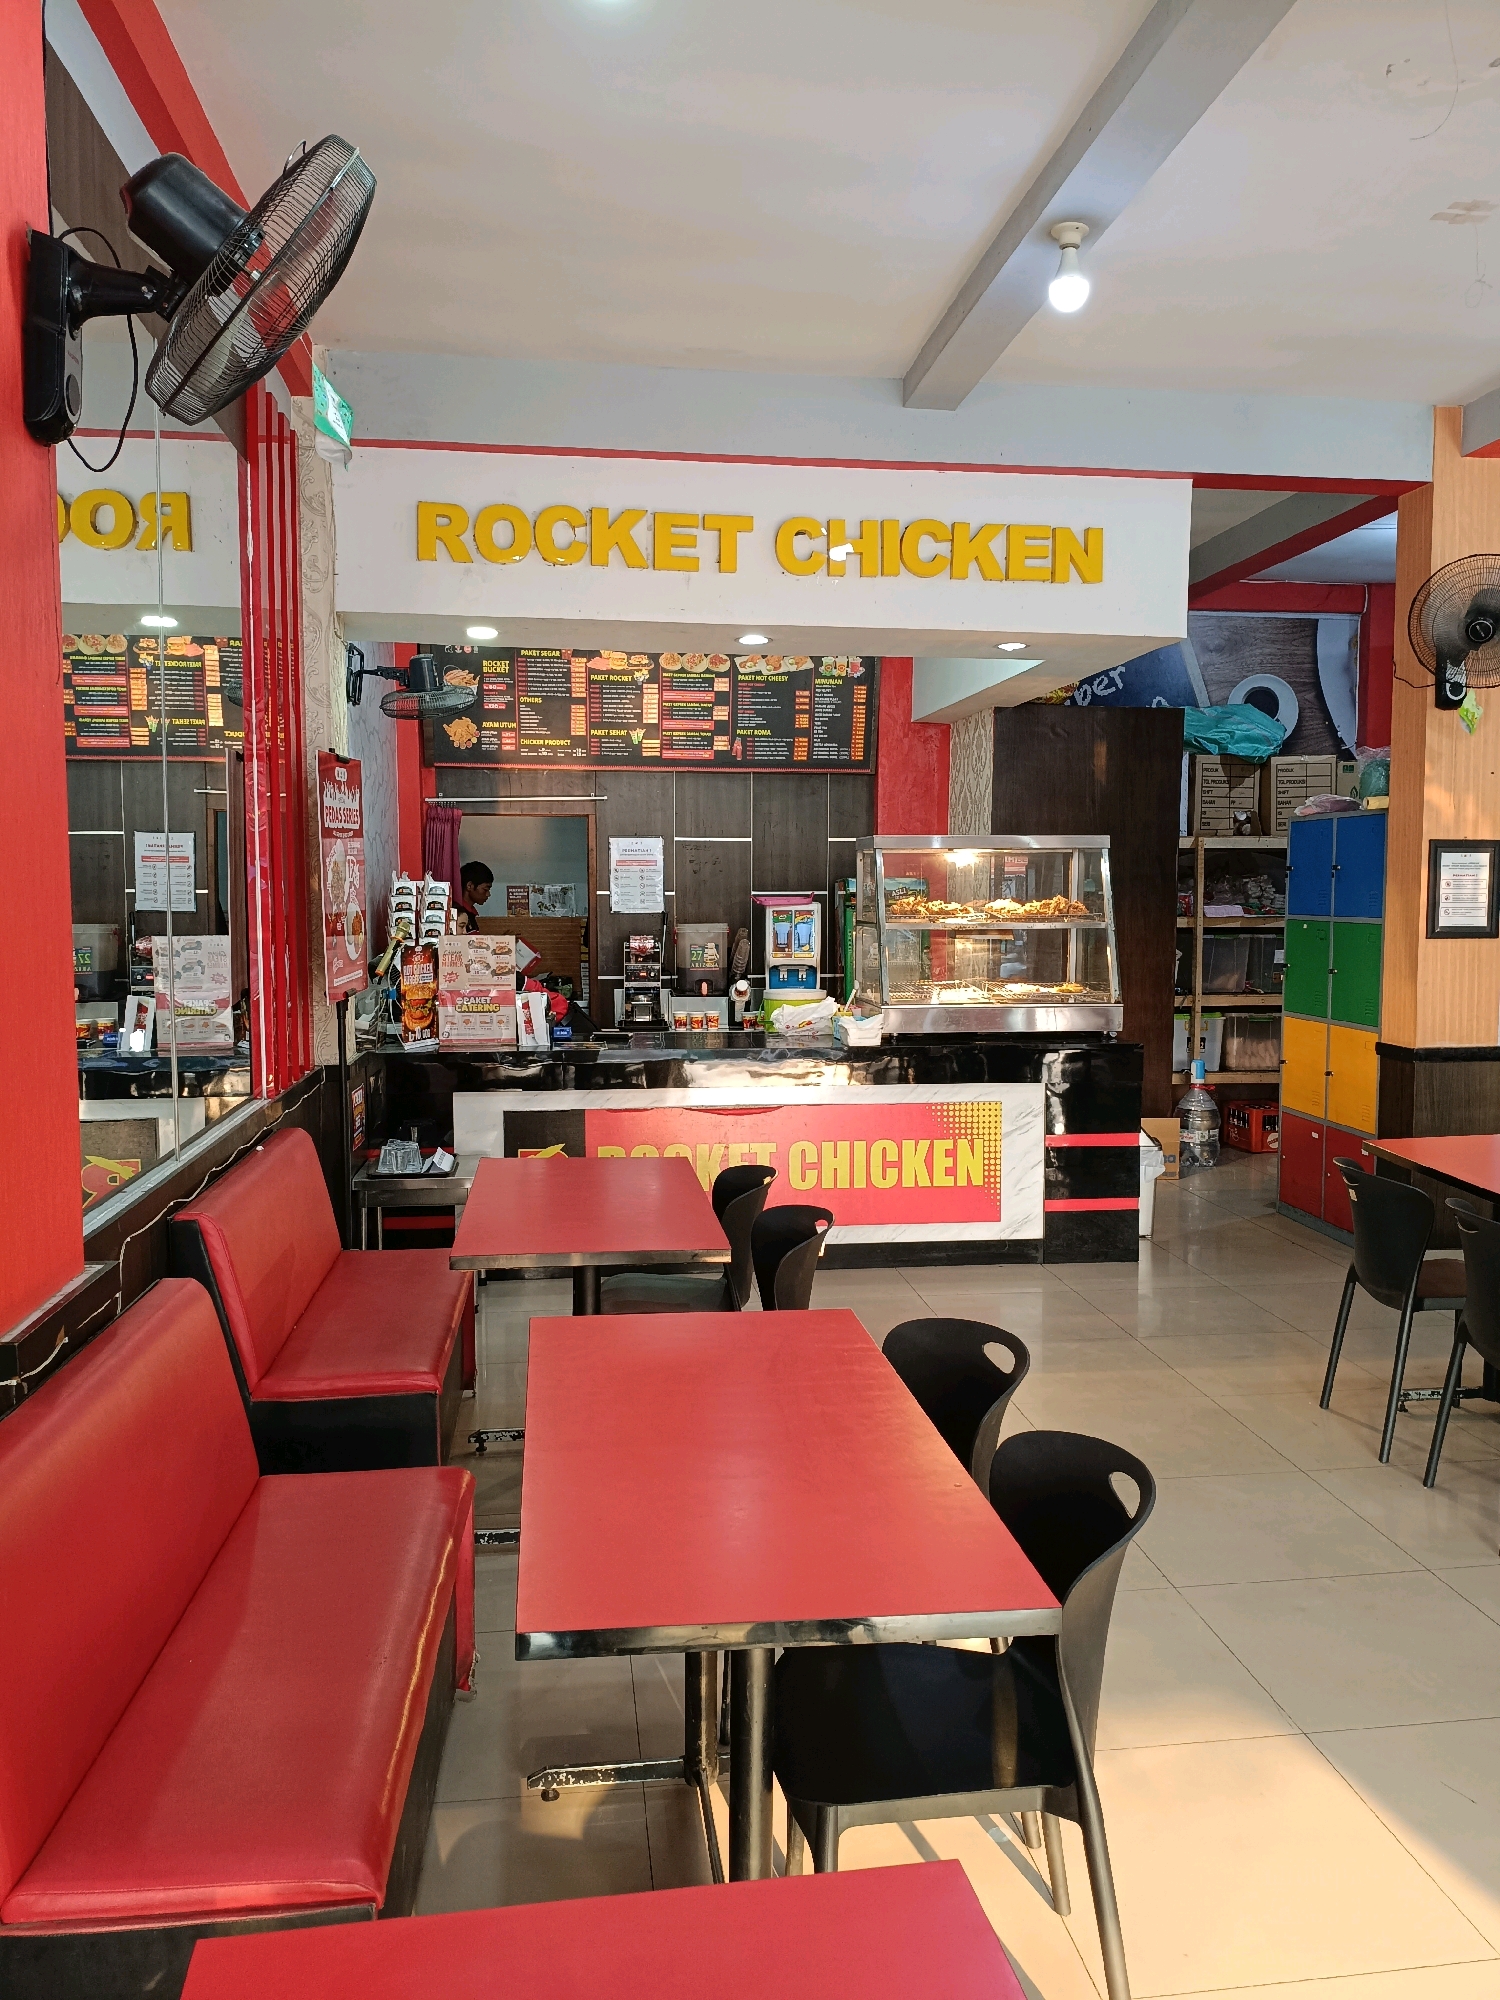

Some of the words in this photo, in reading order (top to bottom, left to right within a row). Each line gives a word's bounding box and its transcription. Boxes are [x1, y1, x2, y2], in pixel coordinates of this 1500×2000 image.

[417, 501, 754, 574] ROCKET
[775, 516, 1103, 584] CHICKEN
[325, 805, 342, 824] PEDAS
[342, 808, 359, 825] SERIES
[891, 886, 907, 897] ASLI
[691, 950, 703, 961] 27
[464, 996, 492, 1004] PAKET
[455, 1003, 500, 1012] CATERING
[788, 1138, 984, 1191] CHICKEN
